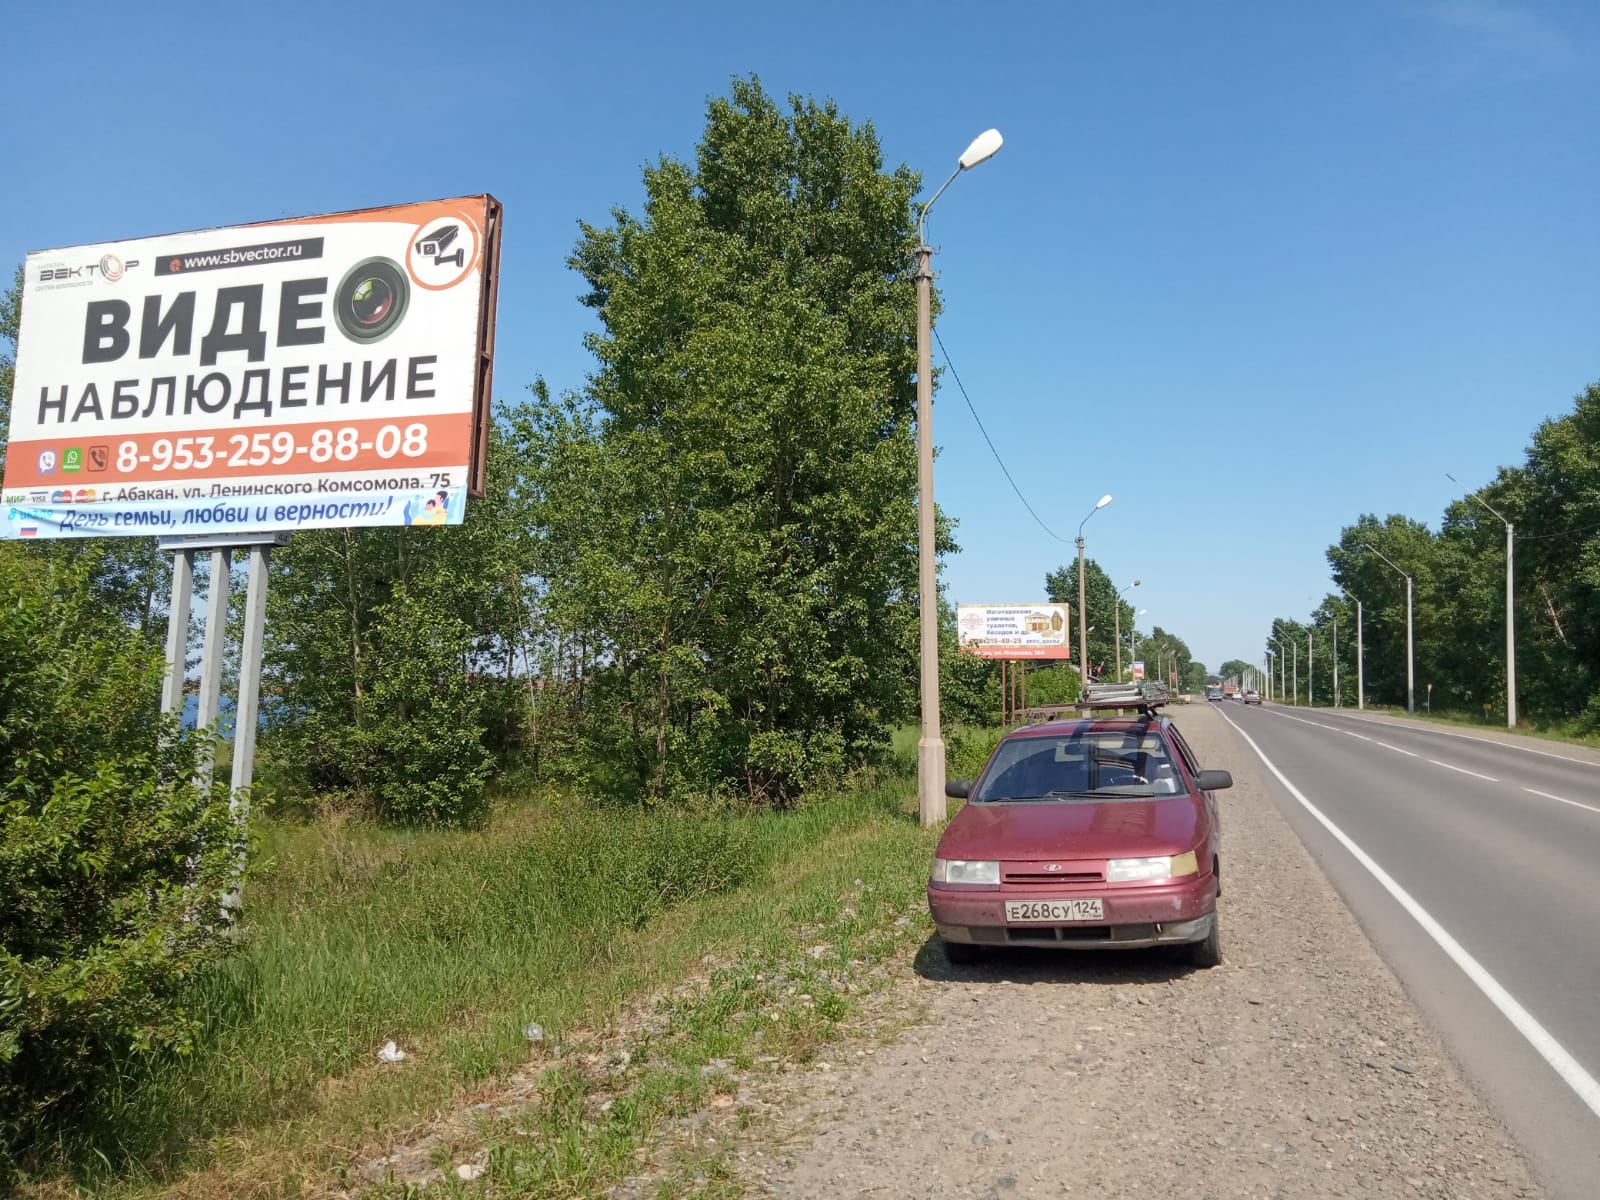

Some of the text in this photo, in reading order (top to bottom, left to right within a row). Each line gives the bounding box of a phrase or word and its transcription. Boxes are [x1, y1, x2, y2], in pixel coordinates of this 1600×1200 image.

[40, 254, 140, 282] ВЕКТОР
[184, 244, 302, 269] www.sbvector.ru
[37, 355, 437, 425] НАБЛЮДЕНИЕ
[116, 423, 428, 473] 8-953-259-88-08
[209, 482, 313, 499] Ленинского
[430, 473, 451, 488] 75
[60, 495, 394, 532] День семьи, любви и верности!
[1011, 901, 1099, 919] Е268СУ 124
